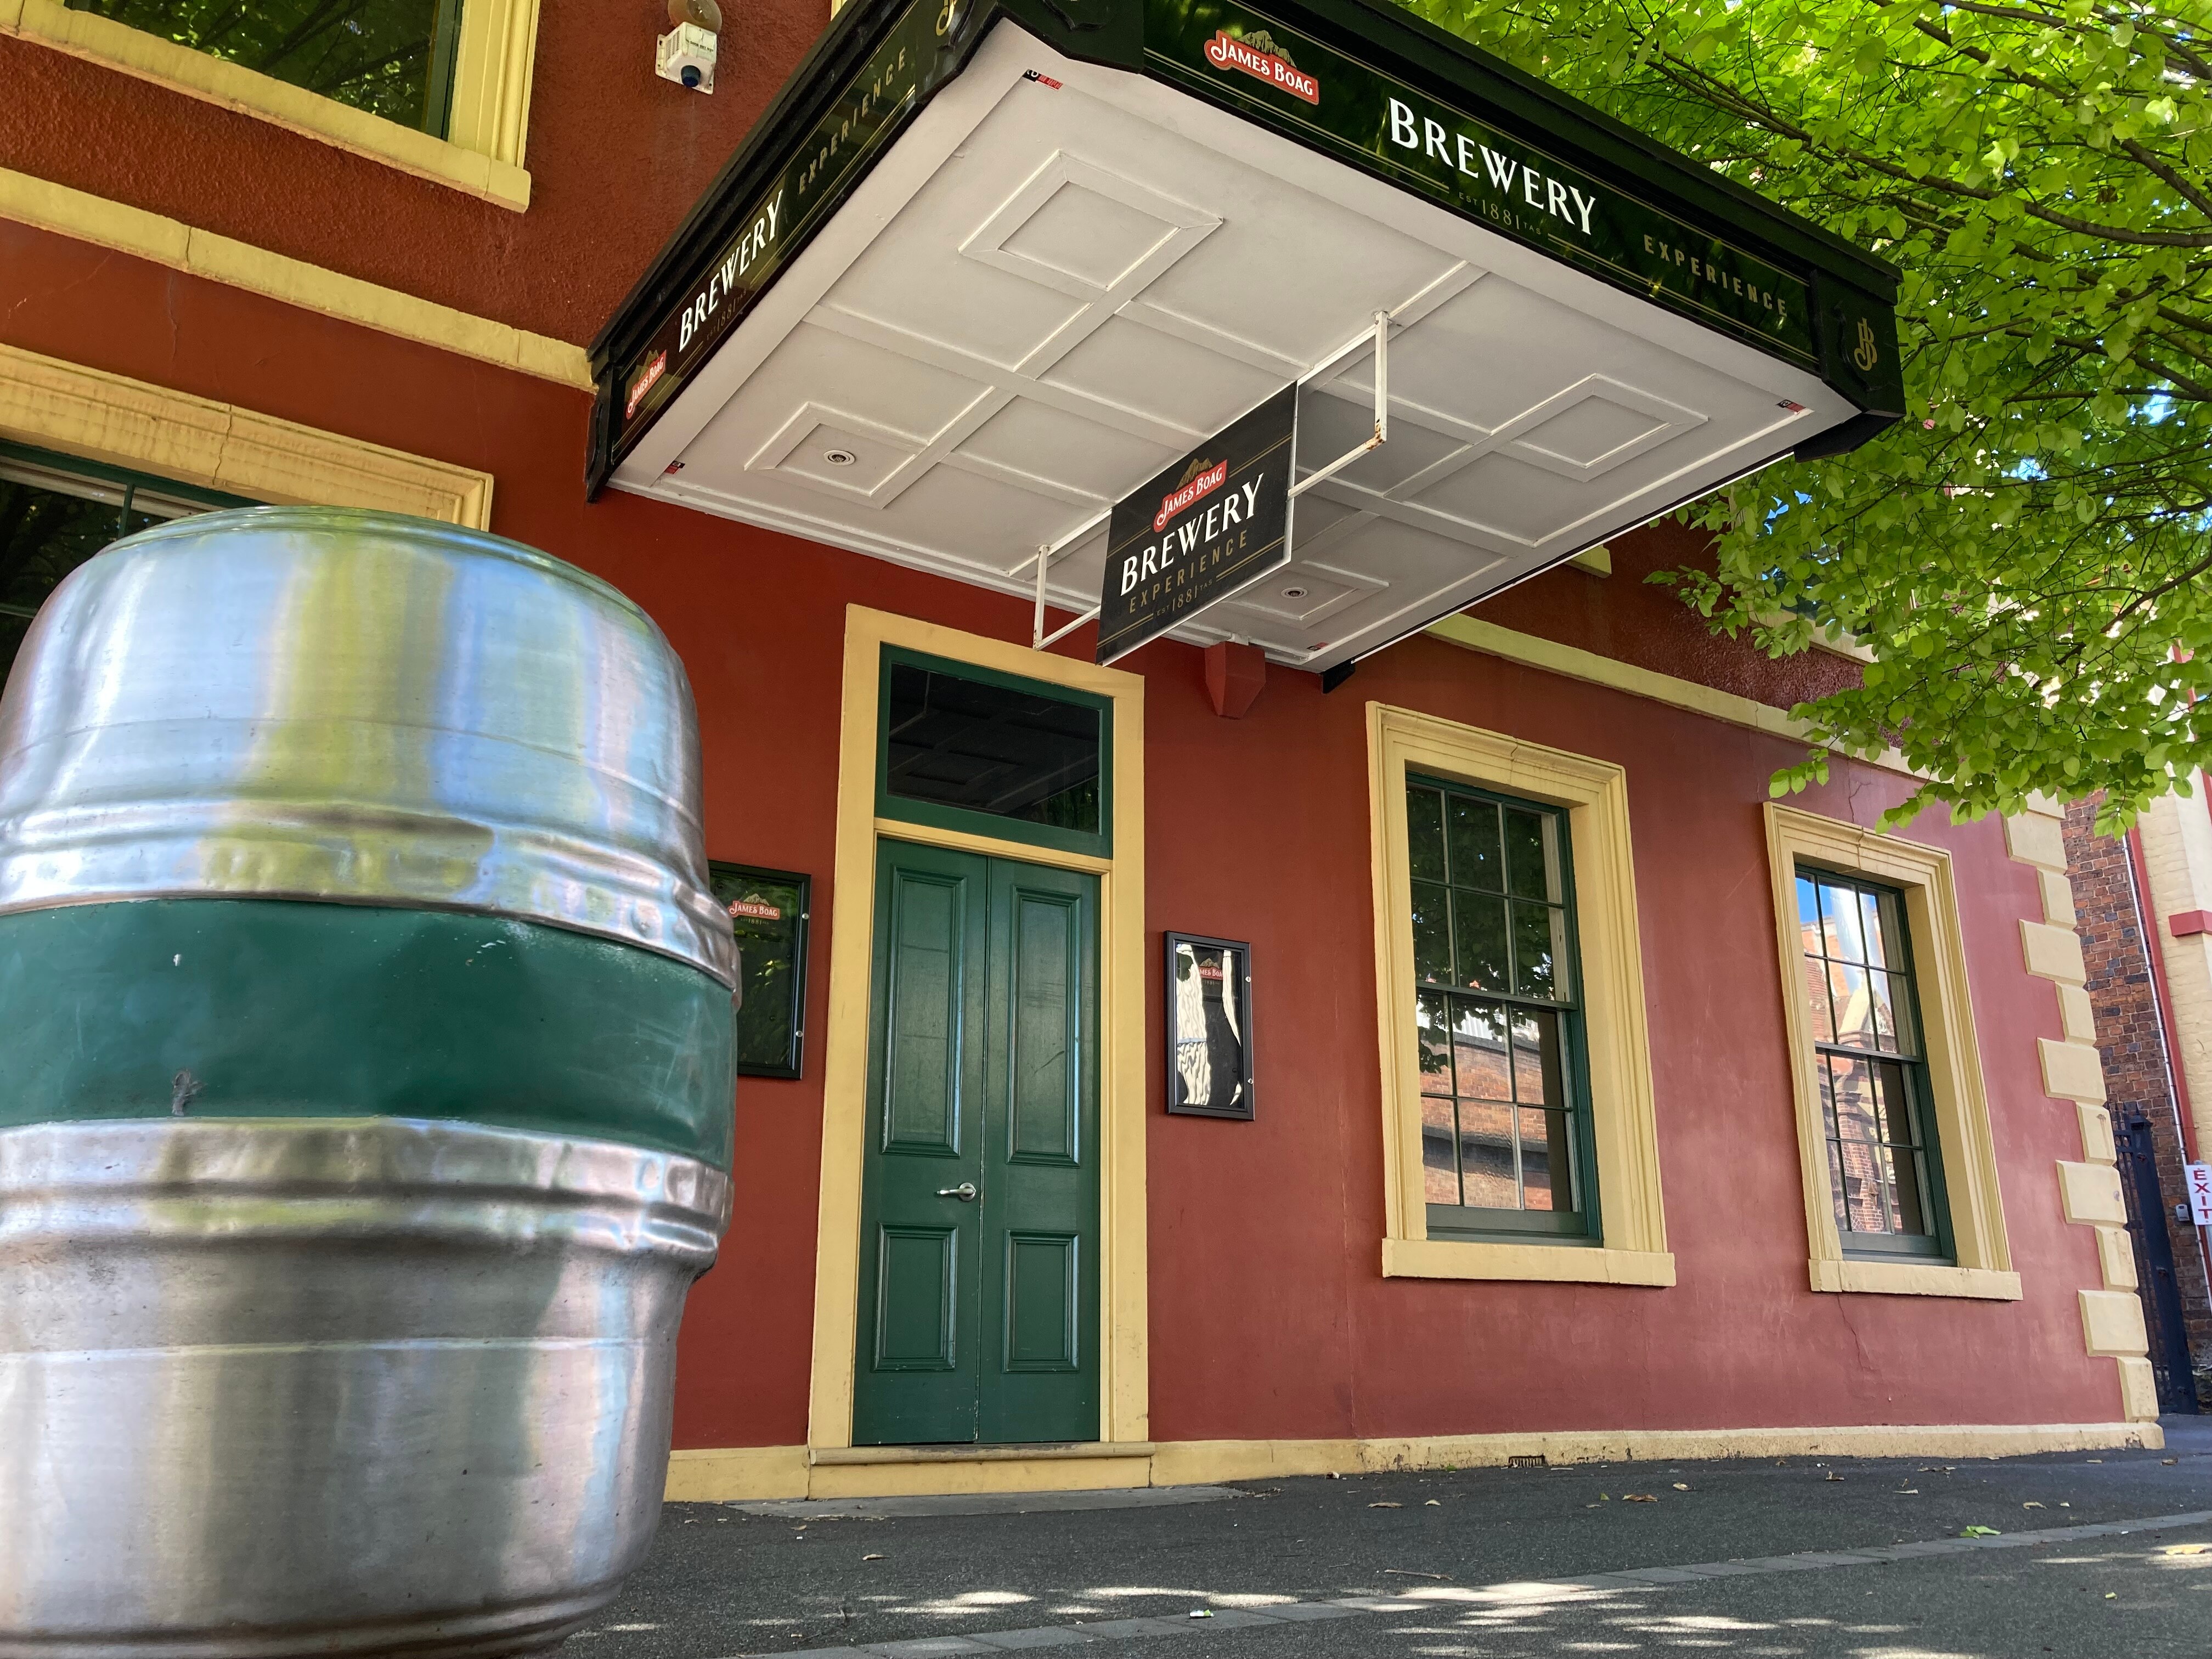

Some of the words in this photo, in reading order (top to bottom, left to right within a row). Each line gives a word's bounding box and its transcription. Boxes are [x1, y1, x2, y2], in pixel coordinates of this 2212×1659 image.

[1210, 37, 1270, 76] JAMES
[1274, 61, 1313, 96] BOAG
[799, 47, 907, 194] EXPERIENCE
[1389, 97, 1596, 235] BREWERY
[1459, 191, 1477, 206] EST
[1482, 200, 1520, 230] 1881
[1523, 221, 1541, 235] TAS
[679, 189, 783, 352] BREWERY
[1644, 234, 1787, 317] EXPERIENCE
[718, 298, 736, 332] 1881
[628, 375, 648, 413] JAMES
[649, 357, 663, 383] BOAG
[1156, 487, 1194, 526] JAMES
[1196, 471, 1222, 494] BOAG
[1120, 473, 1264, 596] BREWERY
[1130, 529, 1248, 613] EXPERIENCE
[1157, 605, 1170, 616] EST
[1172, 585, 1198, 611] 1881
[1200, 580, 1212, 590] TAS
[729, 902, 757, 914] JAMES
[759, 906, 777, 916] BOAG
[1212, 969, 1223, 978] BOA
[2194, 1170, 2212, 1219] EXIT
